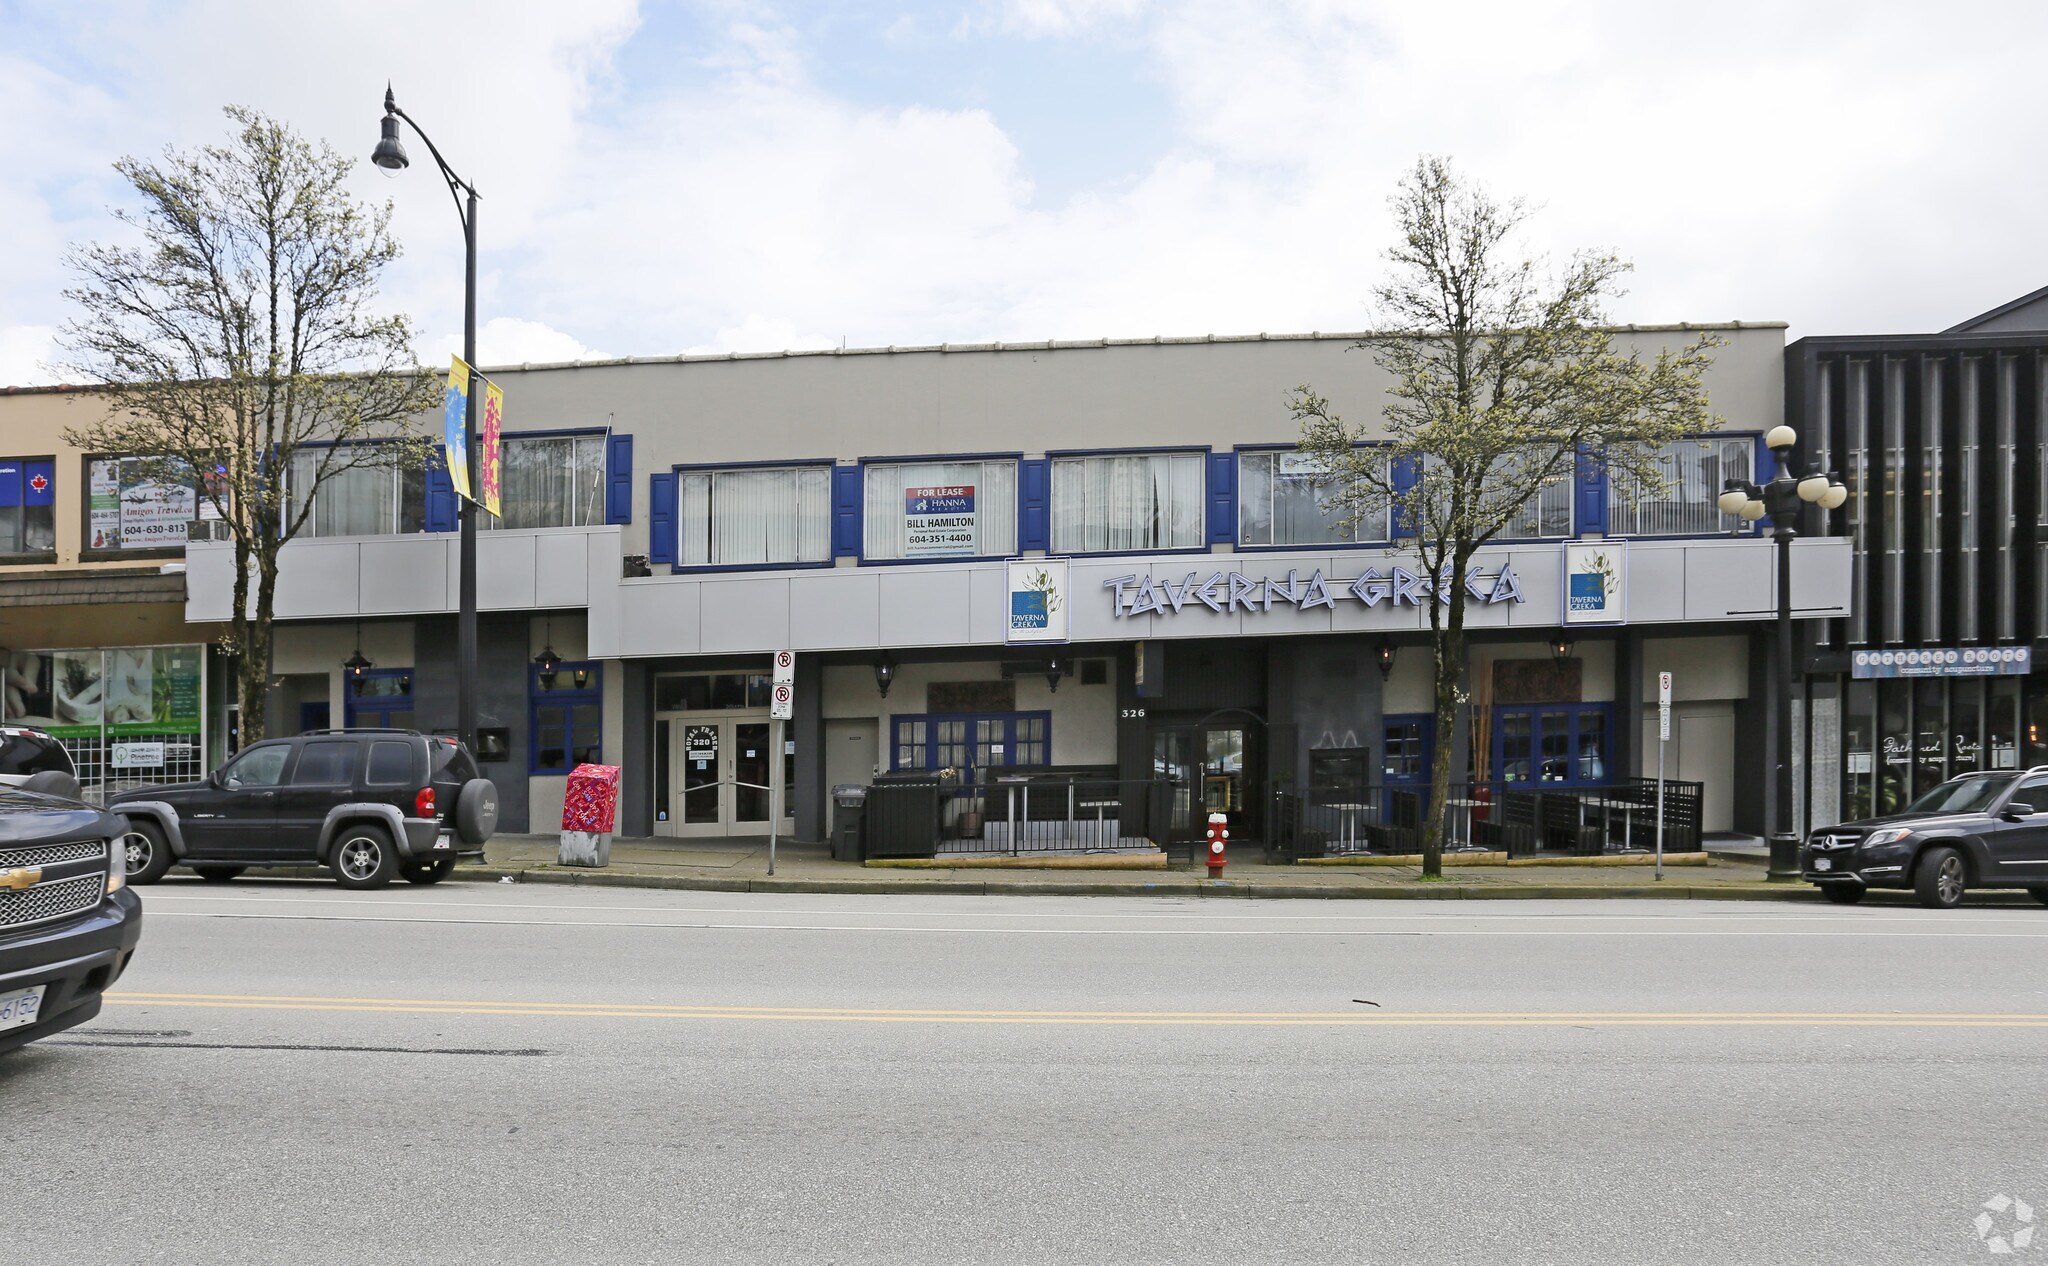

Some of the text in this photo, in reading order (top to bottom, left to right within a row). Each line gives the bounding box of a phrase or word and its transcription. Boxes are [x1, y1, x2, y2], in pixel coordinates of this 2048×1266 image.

[917, 488, 963, 497] FOR LEASE
[932, 499, 966, 507] HANNA
[125, 506, 153, 517] Amigos
[907, 518, 974, 529] BILL HAMILTON
[125, 525, 185, 534] 604-630-813
[909, 534, 972, 544] 604-351-4400
[1103, 568, 1335, 617] TAVERNA
[1570, 596, 1603, 604] TAVERNA
[1856, 649, 2027, 665] GATHERED ROOTS
[1122, 709, 1145, 717] 326
[686, 726, 718, 750] ROYAL FRASER
[483, 800, 495, 812] Jeep
